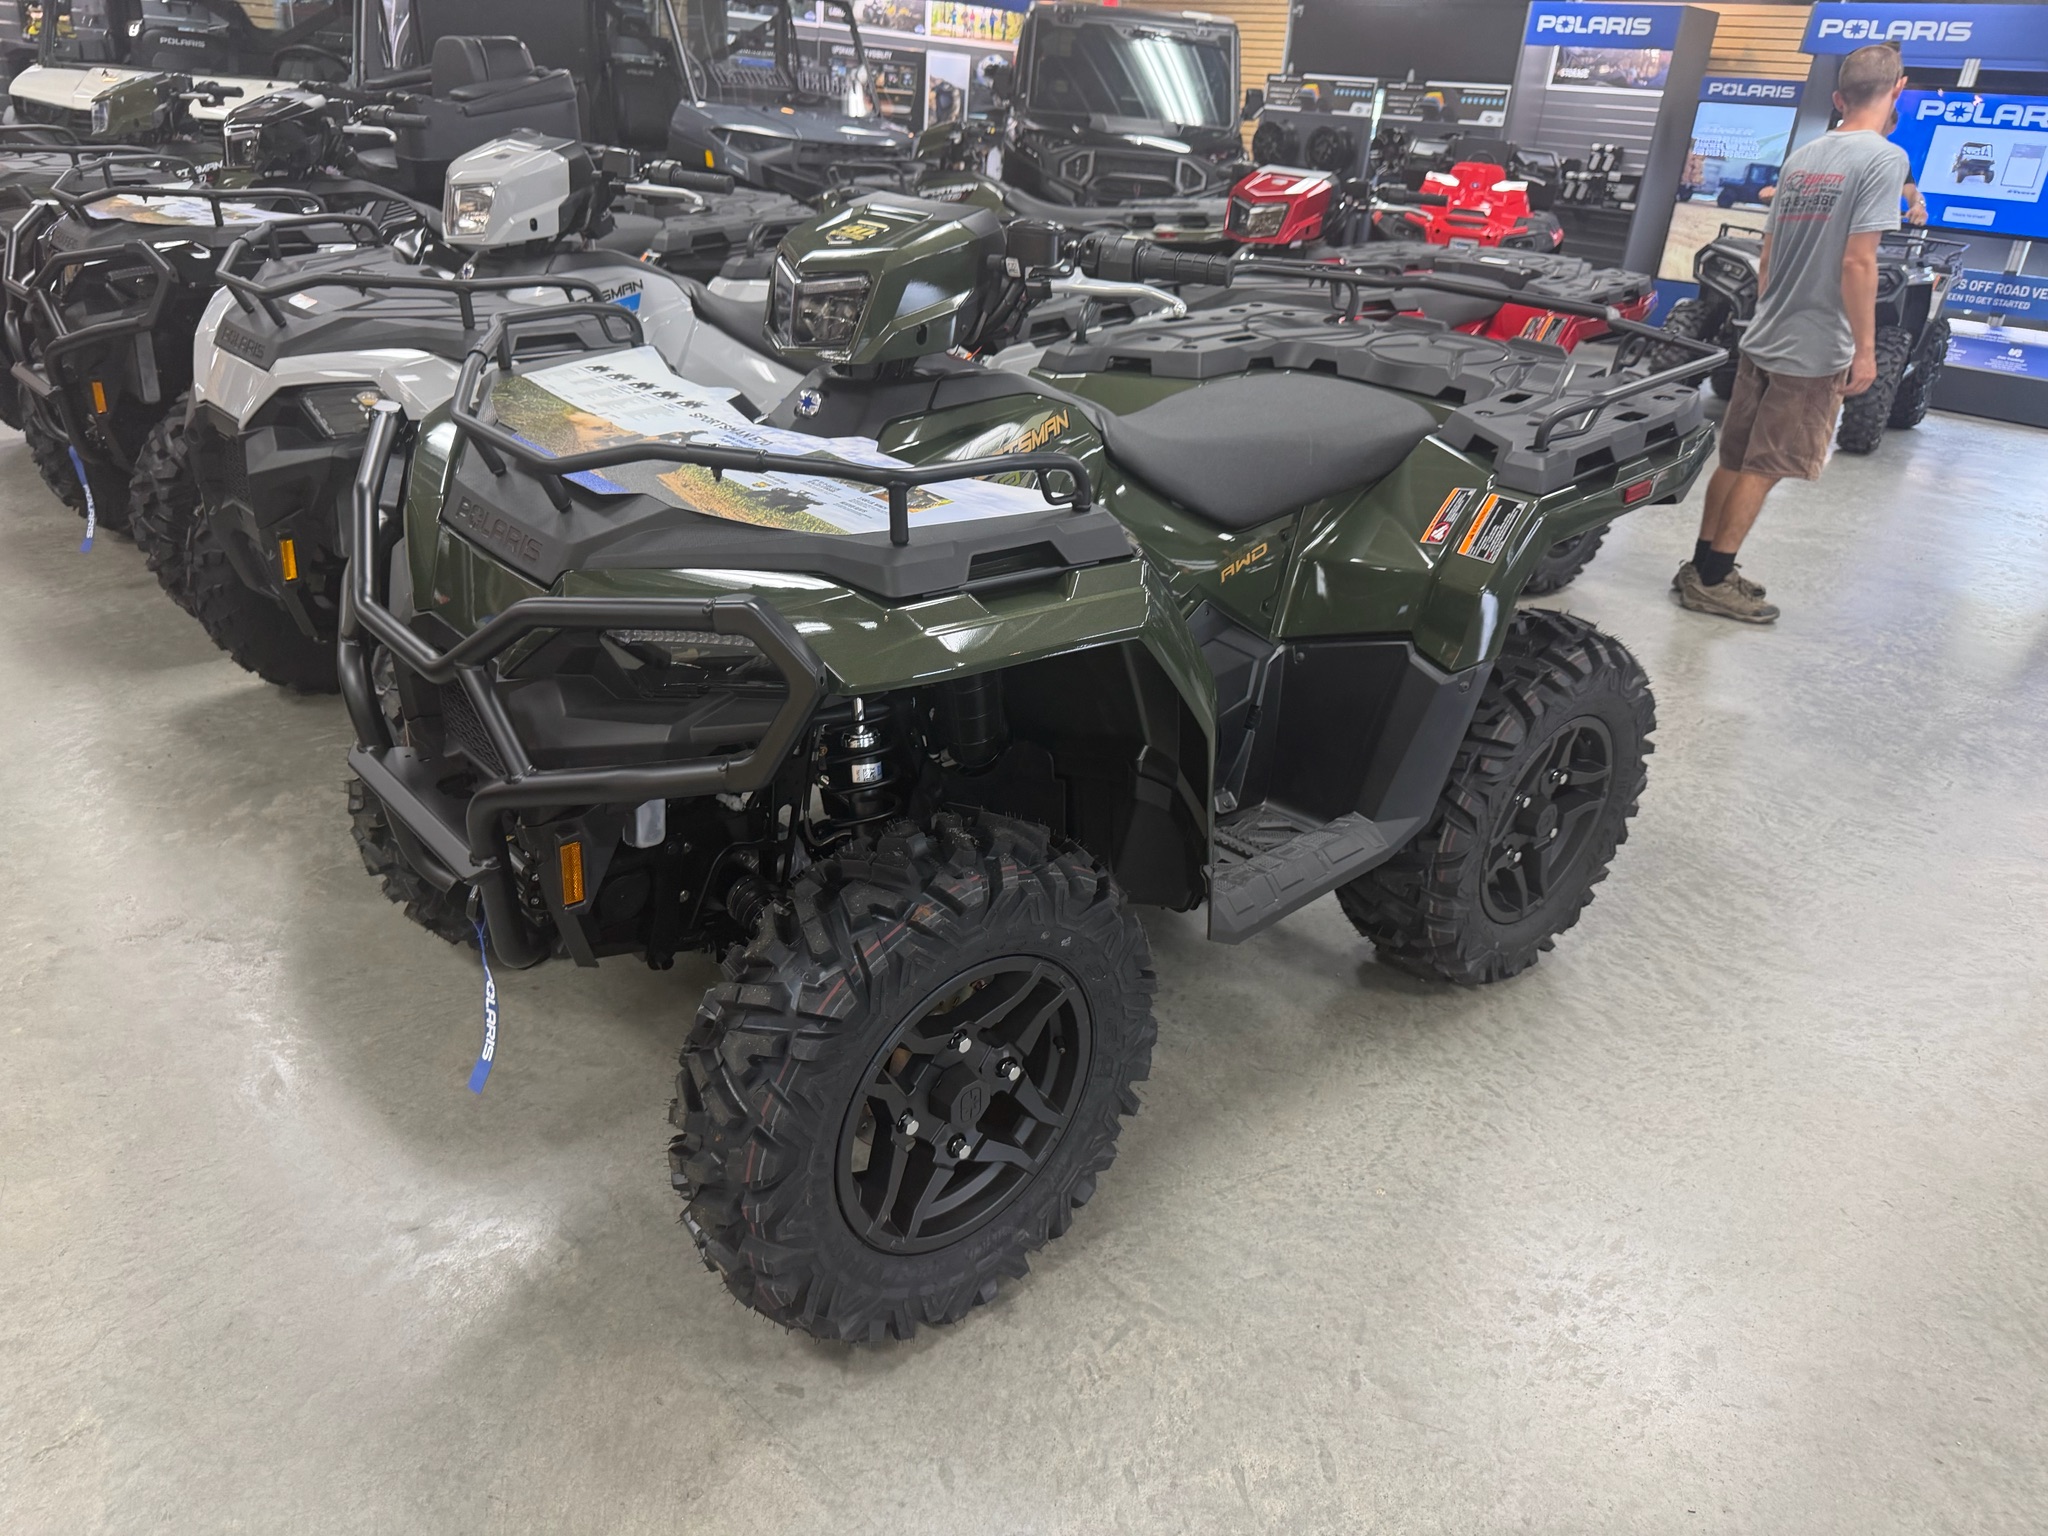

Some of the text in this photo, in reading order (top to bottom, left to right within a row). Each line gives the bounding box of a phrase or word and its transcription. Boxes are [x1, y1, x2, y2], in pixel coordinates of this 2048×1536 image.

[1536, 14, 1652, 36] POLARIS
[1818, 18, 1973, 42] POLARIS
[159, 36, 206, 48] POLARIS
[1707, 82, 1796, 99] POLARIS
[1915, 99, 2048, 128] POLAR
[1968, 280, 1995, 293] OFF
[1994, 283, 2030, 298] ROAD
[1963, 294, 1975, 304] TO
[1975, 295, 1993, 306] GET
[1992, 298, 2031, 310] STARTED
[221, 327, 266, 360] POLARIS
[455, 495, 544, 562] POLARIS
[1220, 542, 1268, 584] AWD
[482, 965, 497, 1062] OLARIS
